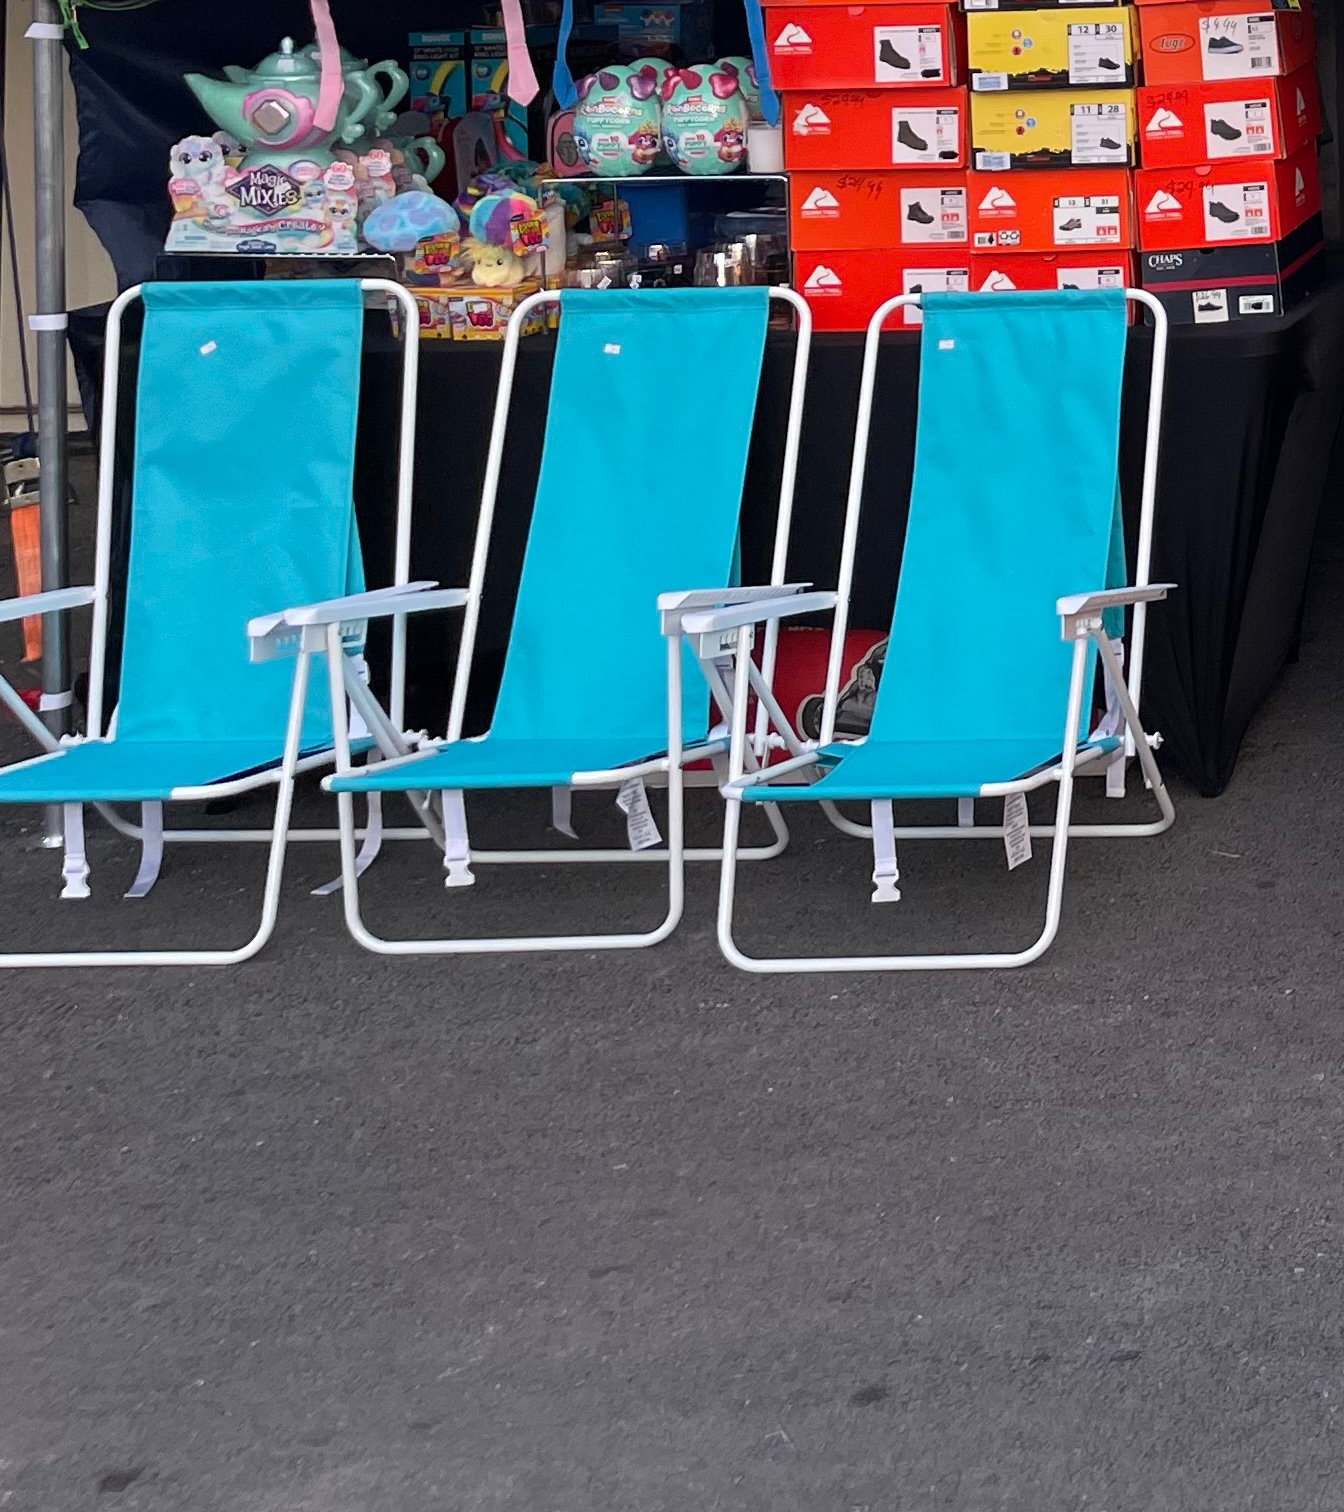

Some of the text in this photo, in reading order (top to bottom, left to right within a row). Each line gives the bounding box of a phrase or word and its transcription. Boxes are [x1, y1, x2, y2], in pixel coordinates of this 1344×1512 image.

[1078, 24, 1117, 34] 12 30
[1108, 105, 1119, 113] 28
[250, 171, 288, 188] Magic
[1149, 254, 1183, 267] CHAPS
